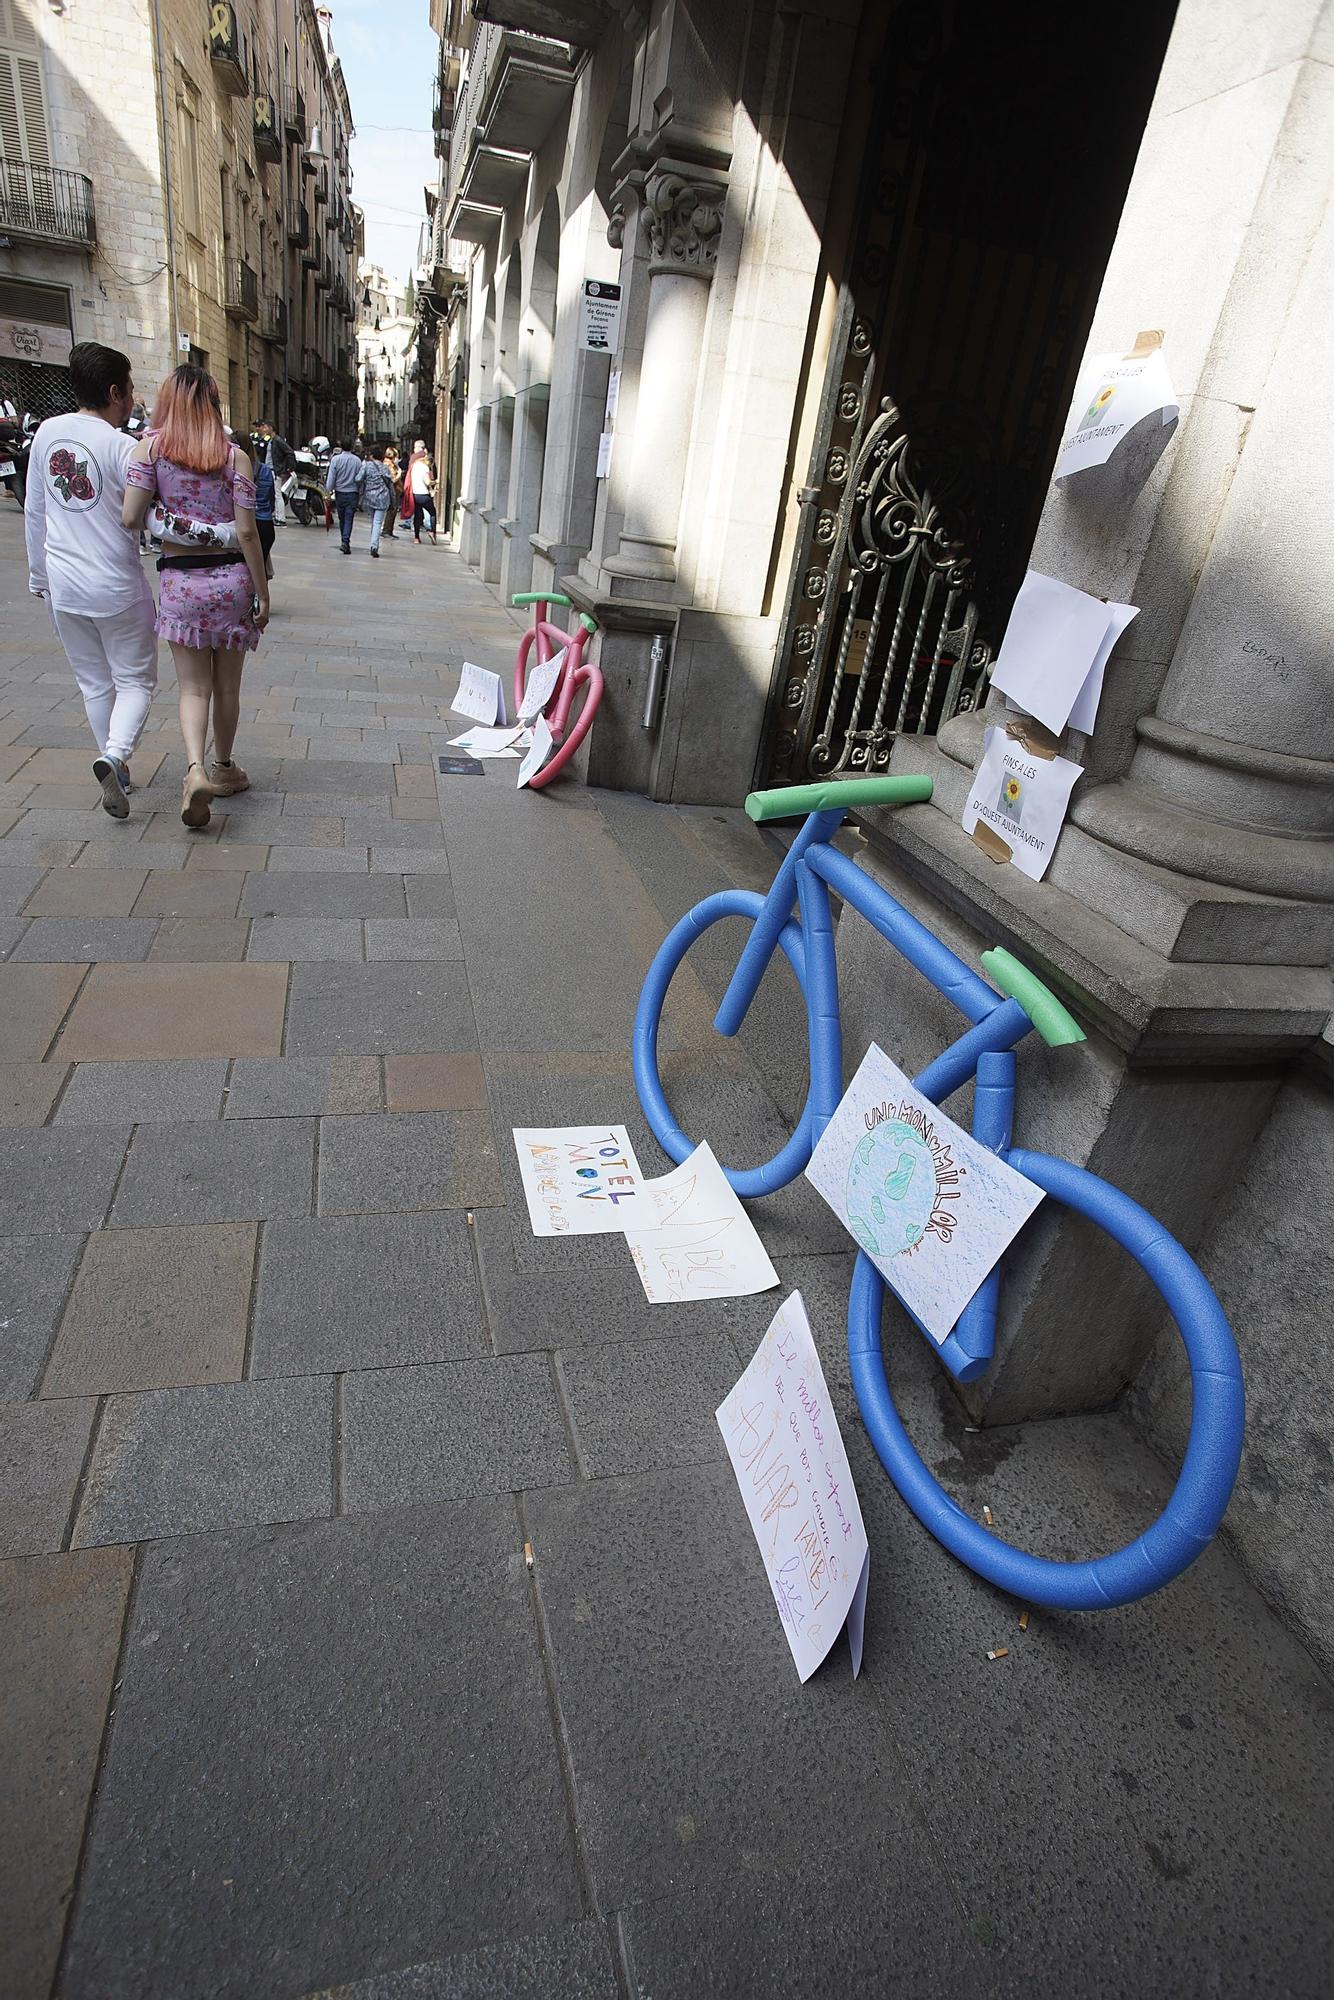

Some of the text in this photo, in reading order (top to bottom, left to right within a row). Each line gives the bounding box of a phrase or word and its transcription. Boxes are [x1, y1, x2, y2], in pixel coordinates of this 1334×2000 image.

[585, 299, 619, 310] Ajuntament
[595, 309, 616, 318] Girona
[853, 630, 867, 640] 15
[1002, 754, 1037, 780] FINS A LES
[972, 800, 1045, 852] D'AQUEST AJUNTAMENT
[864, 1101, 889, 1131] UN
[589, 1132, 636, 1205] TOT EL
[776, 1330, 798, 1371] El
[795, 1377, 824, 1455] millor
[789, 1411, 801, 1444] QUE
[799, 1448, 812, 1484] POTS
[730, 1400, 800, 1547] ANAR
